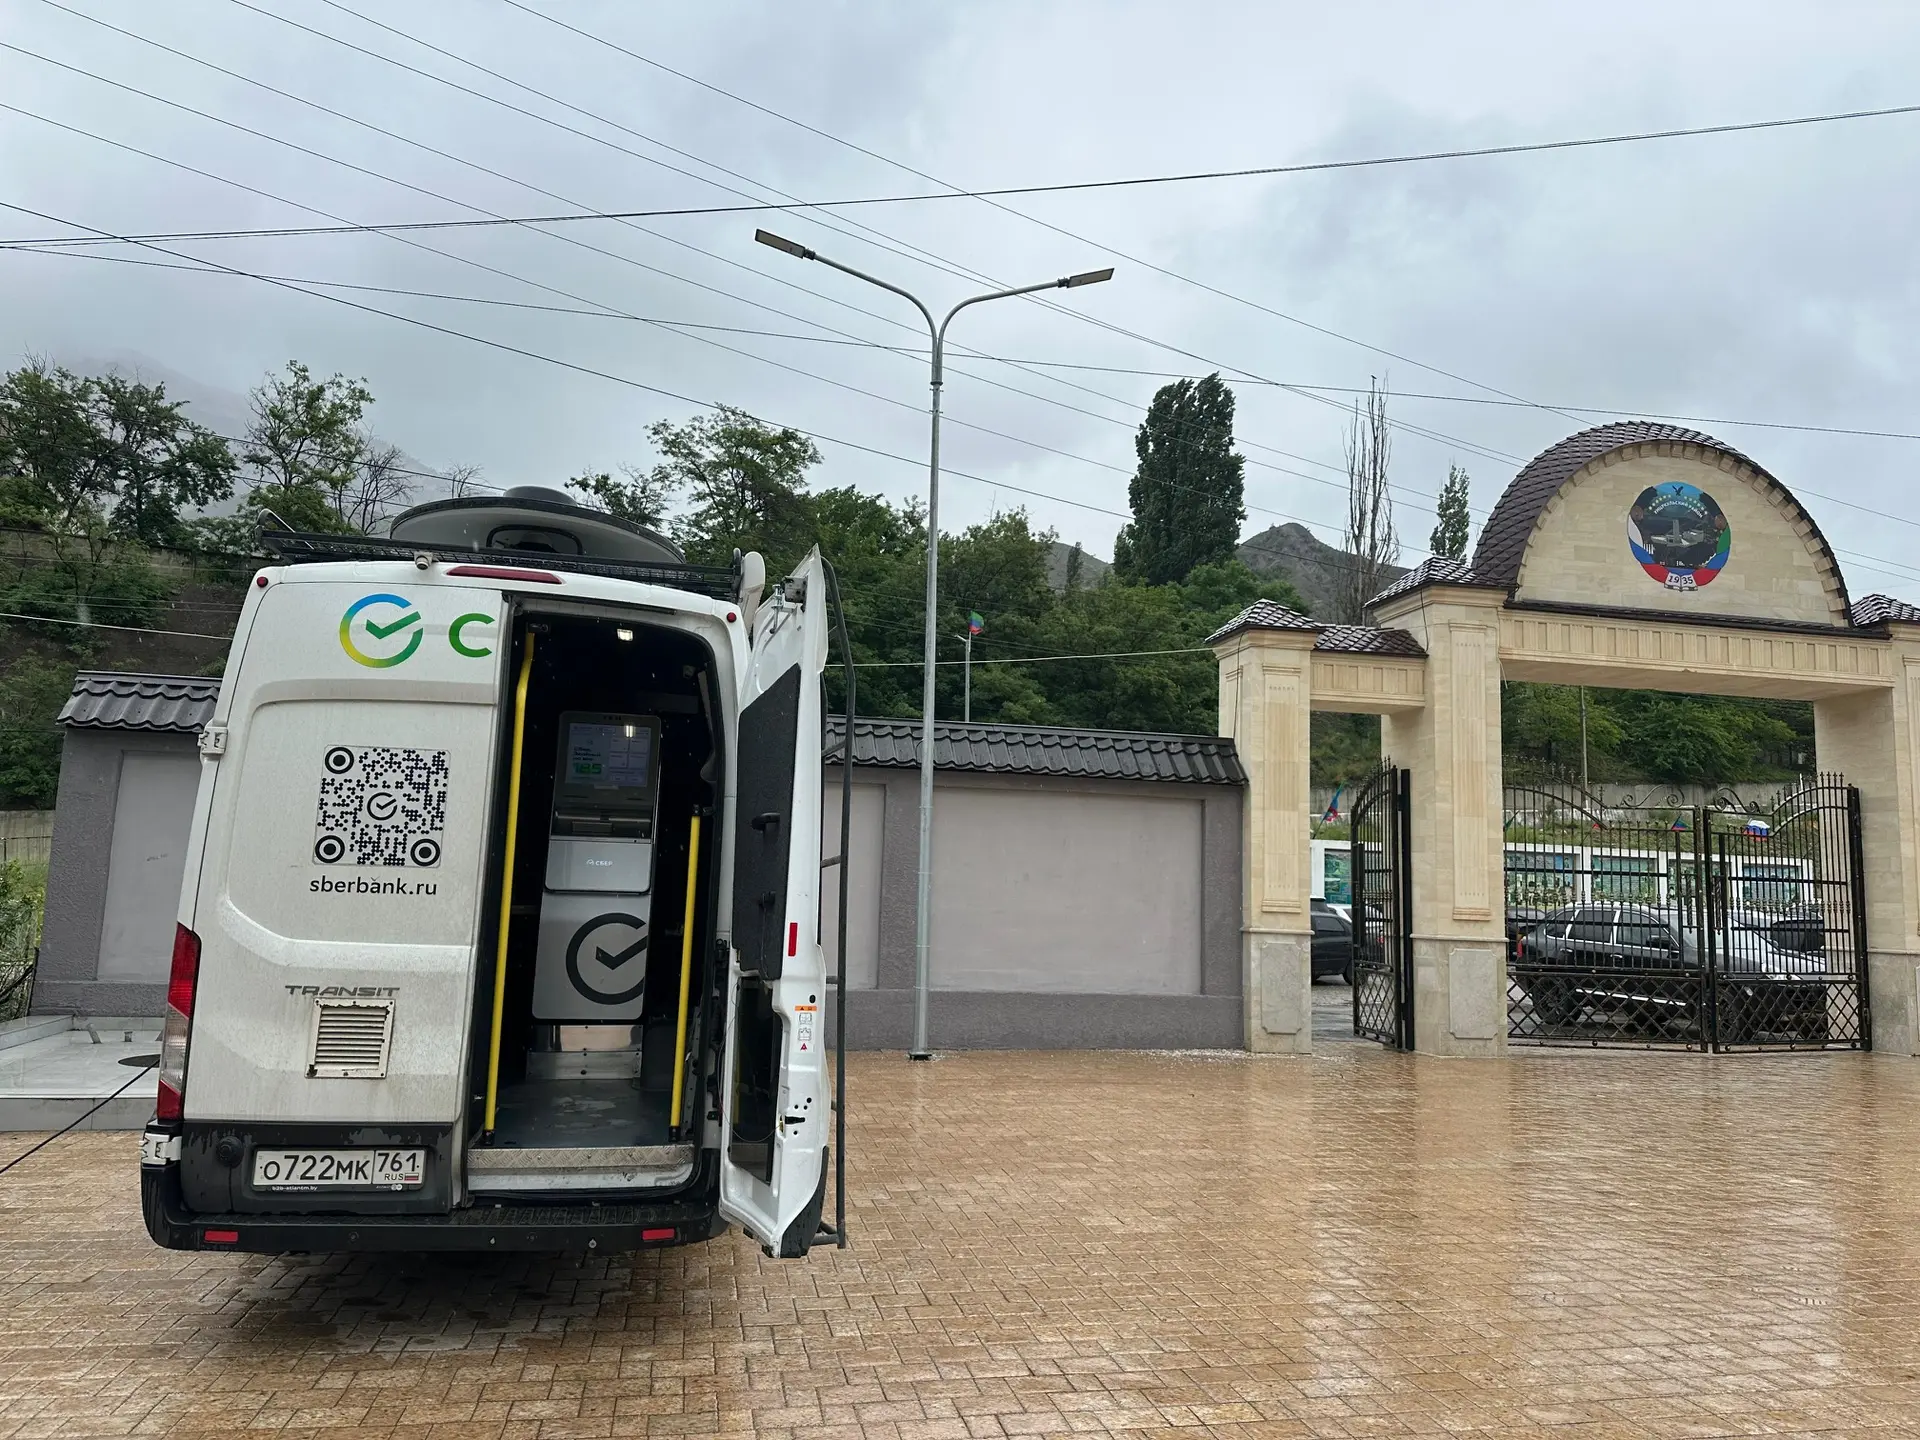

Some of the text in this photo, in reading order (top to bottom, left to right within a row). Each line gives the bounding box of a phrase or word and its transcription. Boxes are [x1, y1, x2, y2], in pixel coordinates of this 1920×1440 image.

[1668, 575, 1693, 585] 1935
[309, 875, 437, 895] sberbank.ru
[285, 985, 400, 997] TRANSIT
[263, 1152, 417, 1181] О722МК 761
[384, 1173, 404, 1181] RUS
